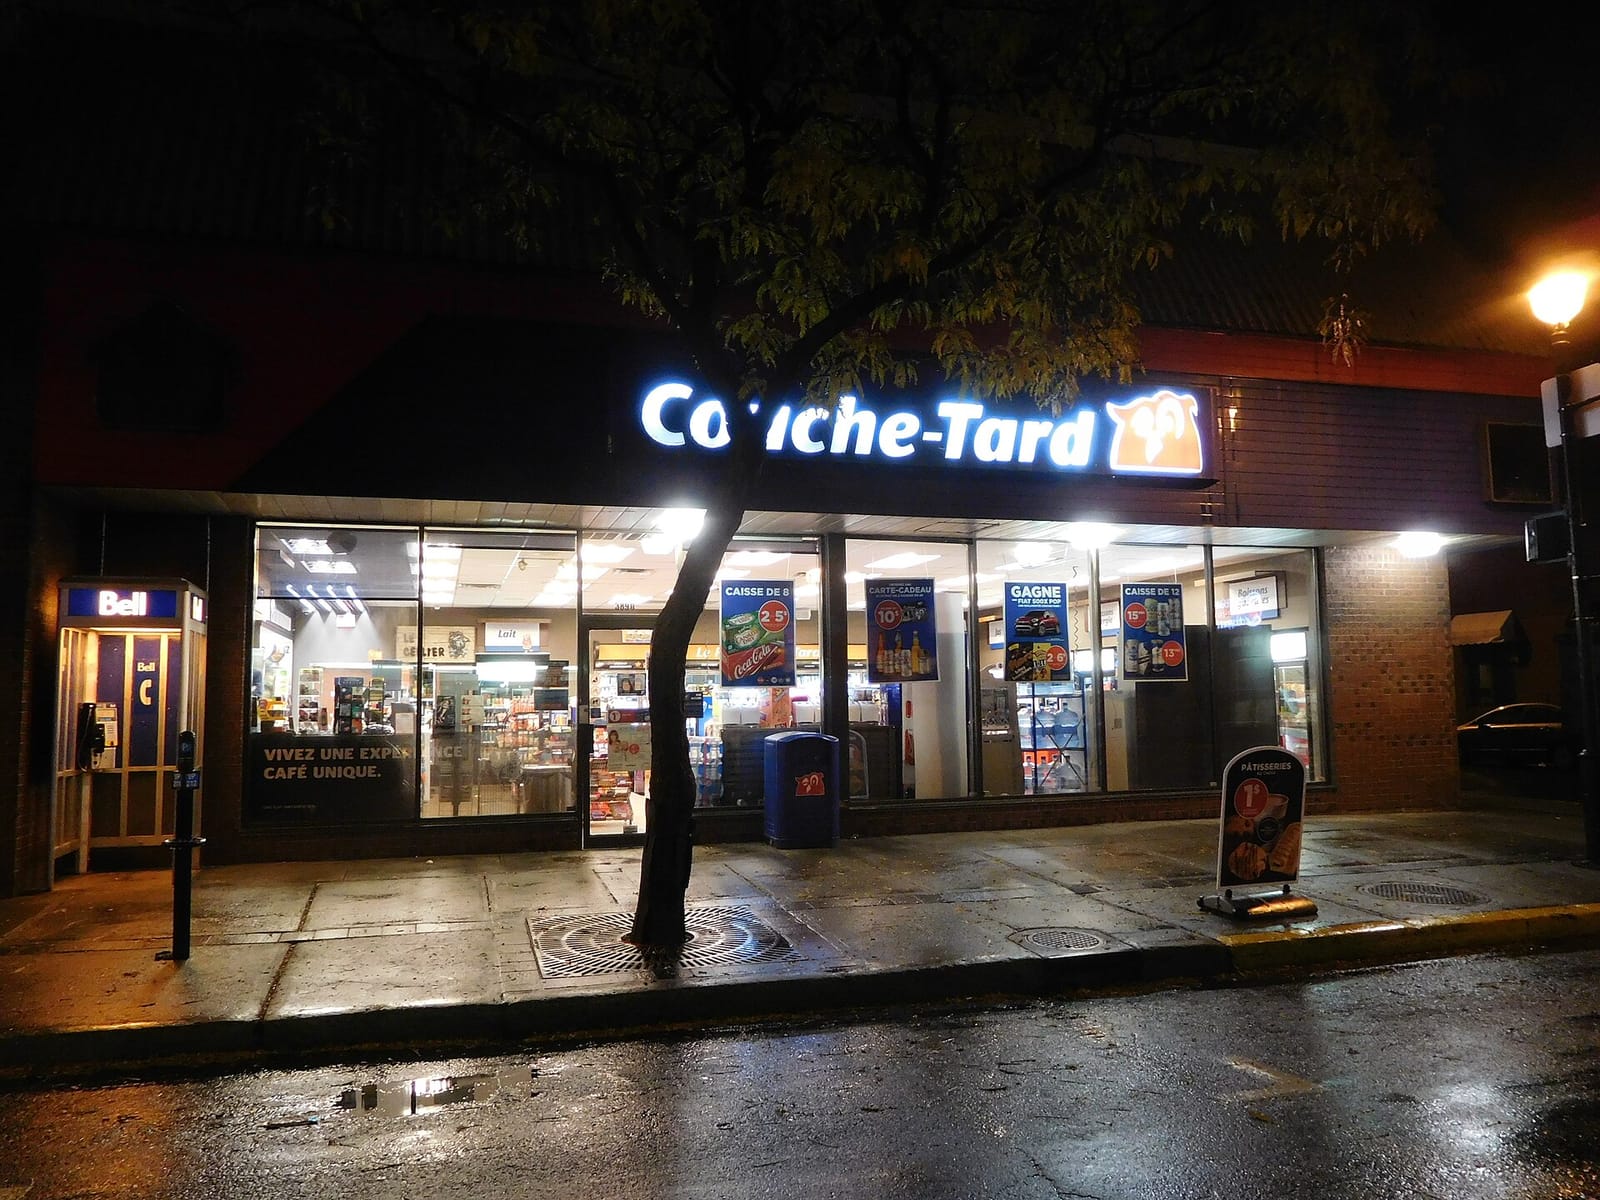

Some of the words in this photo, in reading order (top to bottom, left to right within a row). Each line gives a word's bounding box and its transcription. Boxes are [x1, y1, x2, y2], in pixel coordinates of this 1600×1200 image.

[725, 587, 764, 596] CAISSE
[766, 587, 781, 596] DE
[869, 586, 932, 594] CARTE-CADEAU
[1010, 585, 1062, 598] GAGNE
[1125, 587, 1156, 596] CAISSE
[1158, 588, 1169, 596] DE
[98, 590, 147, 616] Bell
[403, 633, 415, 643] LE
[498, 629, 517, 638] Lait
[403, 646, 445, 657] CELIER
[137, 662, 156, 672] Bell
[263, 748, 315, 761] VIVEZ
[320, 747, 354, 760] UNE
[263, 764, 308, 780] CAFÉ
[313, 765, 381, 780] UNIQUE.
